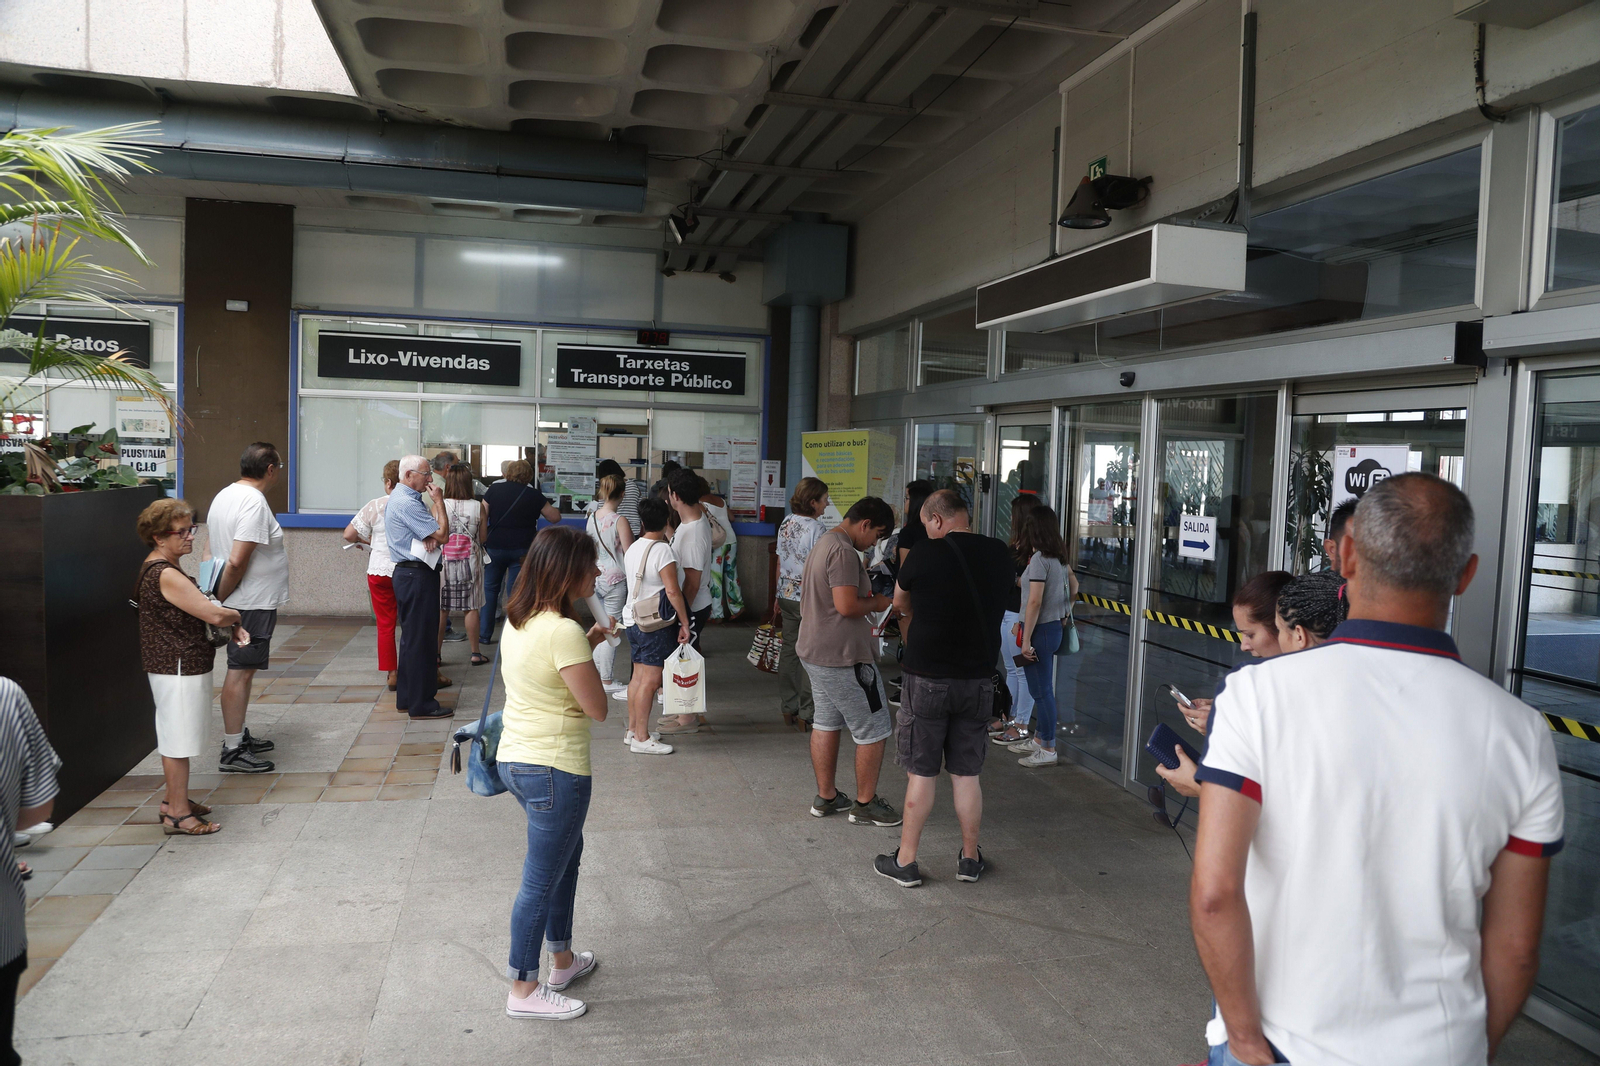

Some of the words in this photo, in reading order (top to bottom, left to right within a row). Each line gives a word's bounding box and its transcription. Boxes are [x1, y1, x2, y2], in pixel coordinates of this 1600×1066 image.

[55, 333, 120, 352] Datos
[348, 348, 491, 371] Lixo-Vivendas
[616, 354, 690, 371] Tarxetas
[570, 368, 665, 388] Transporte
[671, 373, 733, 389] Público
[852, 439, 867, 447] bus?
[121, 447, 166, 459] PLUSVALÍA
[1183, 521, 1210, 534] SALIDA
